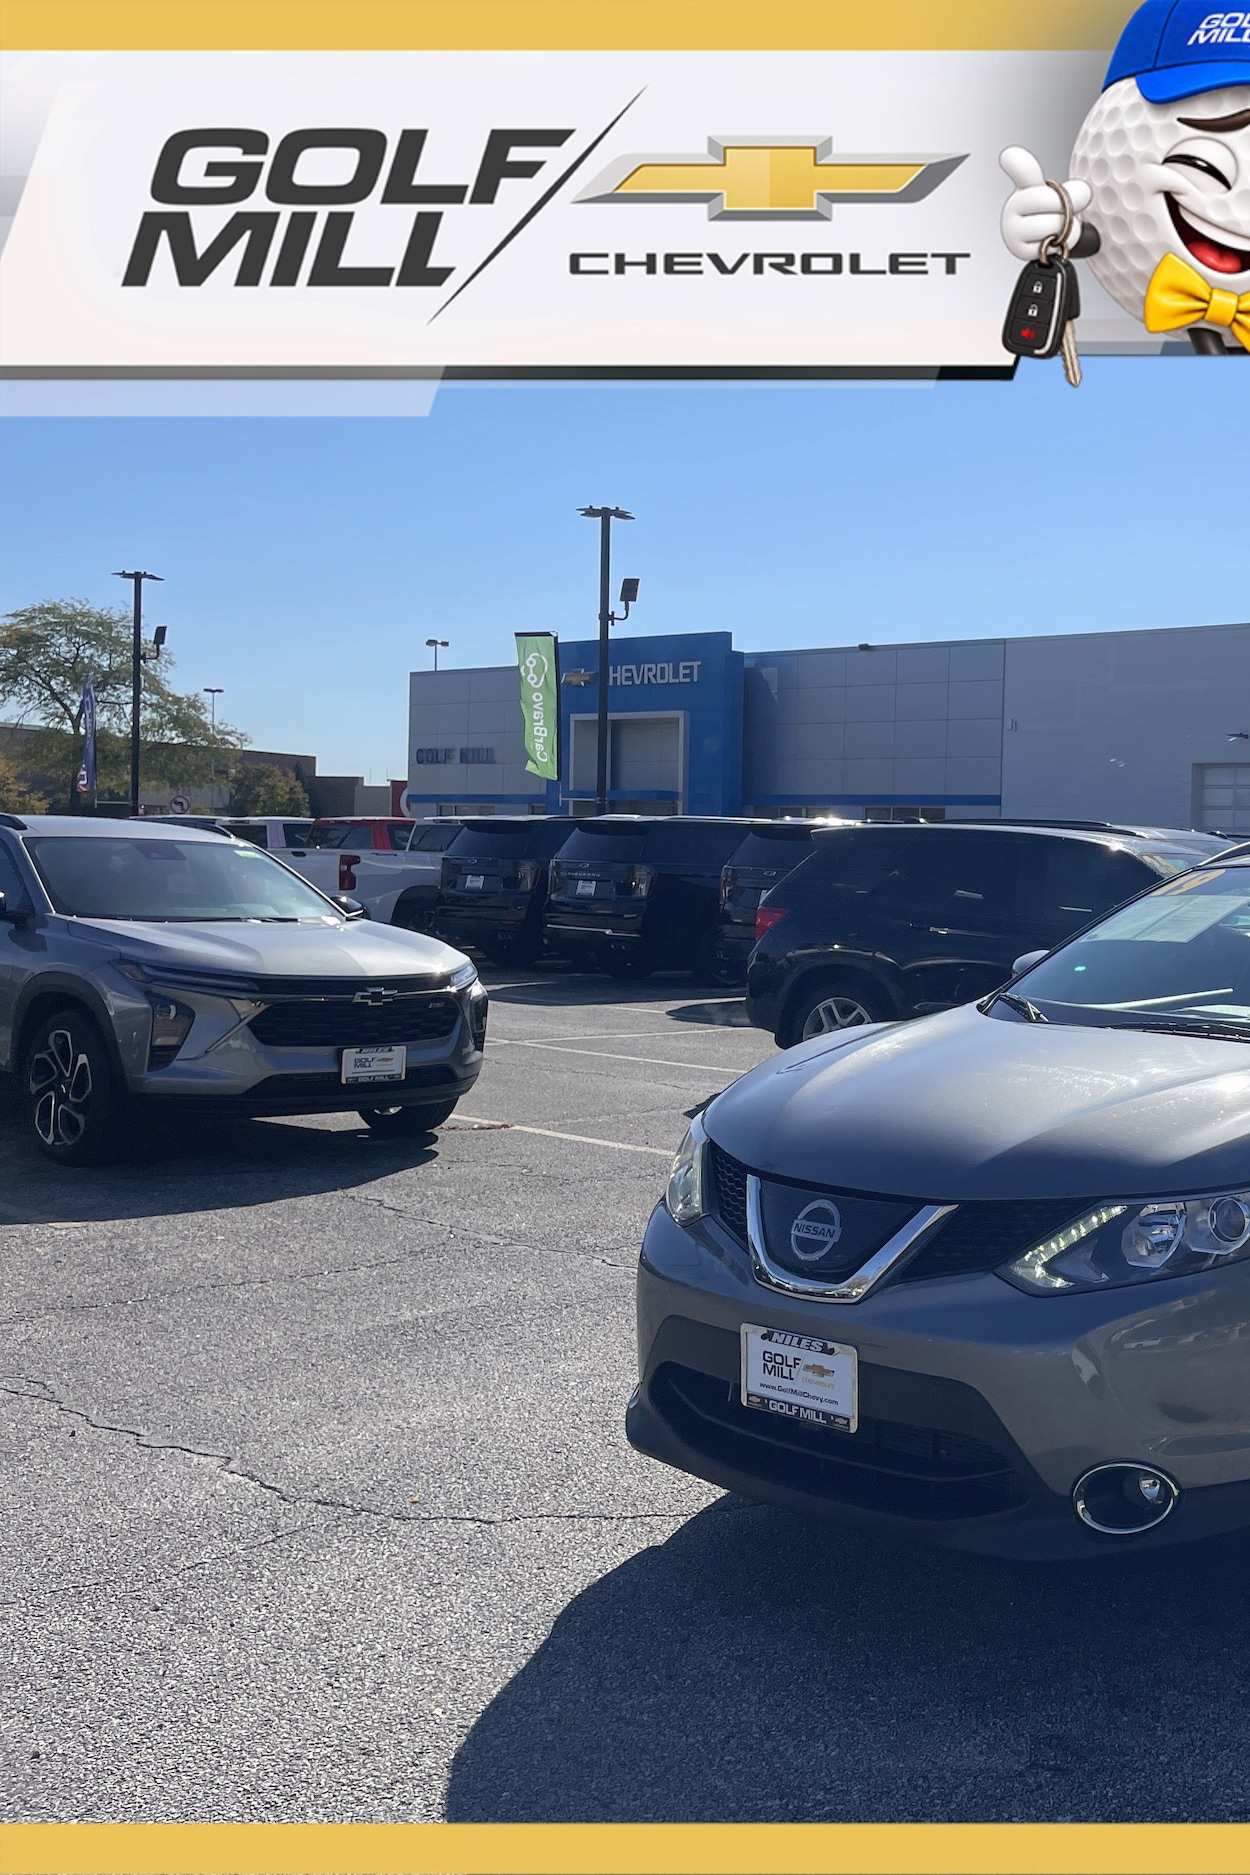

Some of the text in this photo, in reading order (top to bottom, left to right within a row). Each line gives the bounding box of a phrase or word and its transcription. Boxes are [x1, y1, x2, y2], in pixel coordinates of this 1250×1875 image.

[608, 661, 702, 686] HEVROLET
[793, 1223, 835, 1239] NISSAN
[771, 1332, 824, 1352] NILES
[762, 1351, 801, 1369] GOLF
[763, 1363, 794, 1381] MILL
[769, 1401, 827, 1424] GOLF MILL
